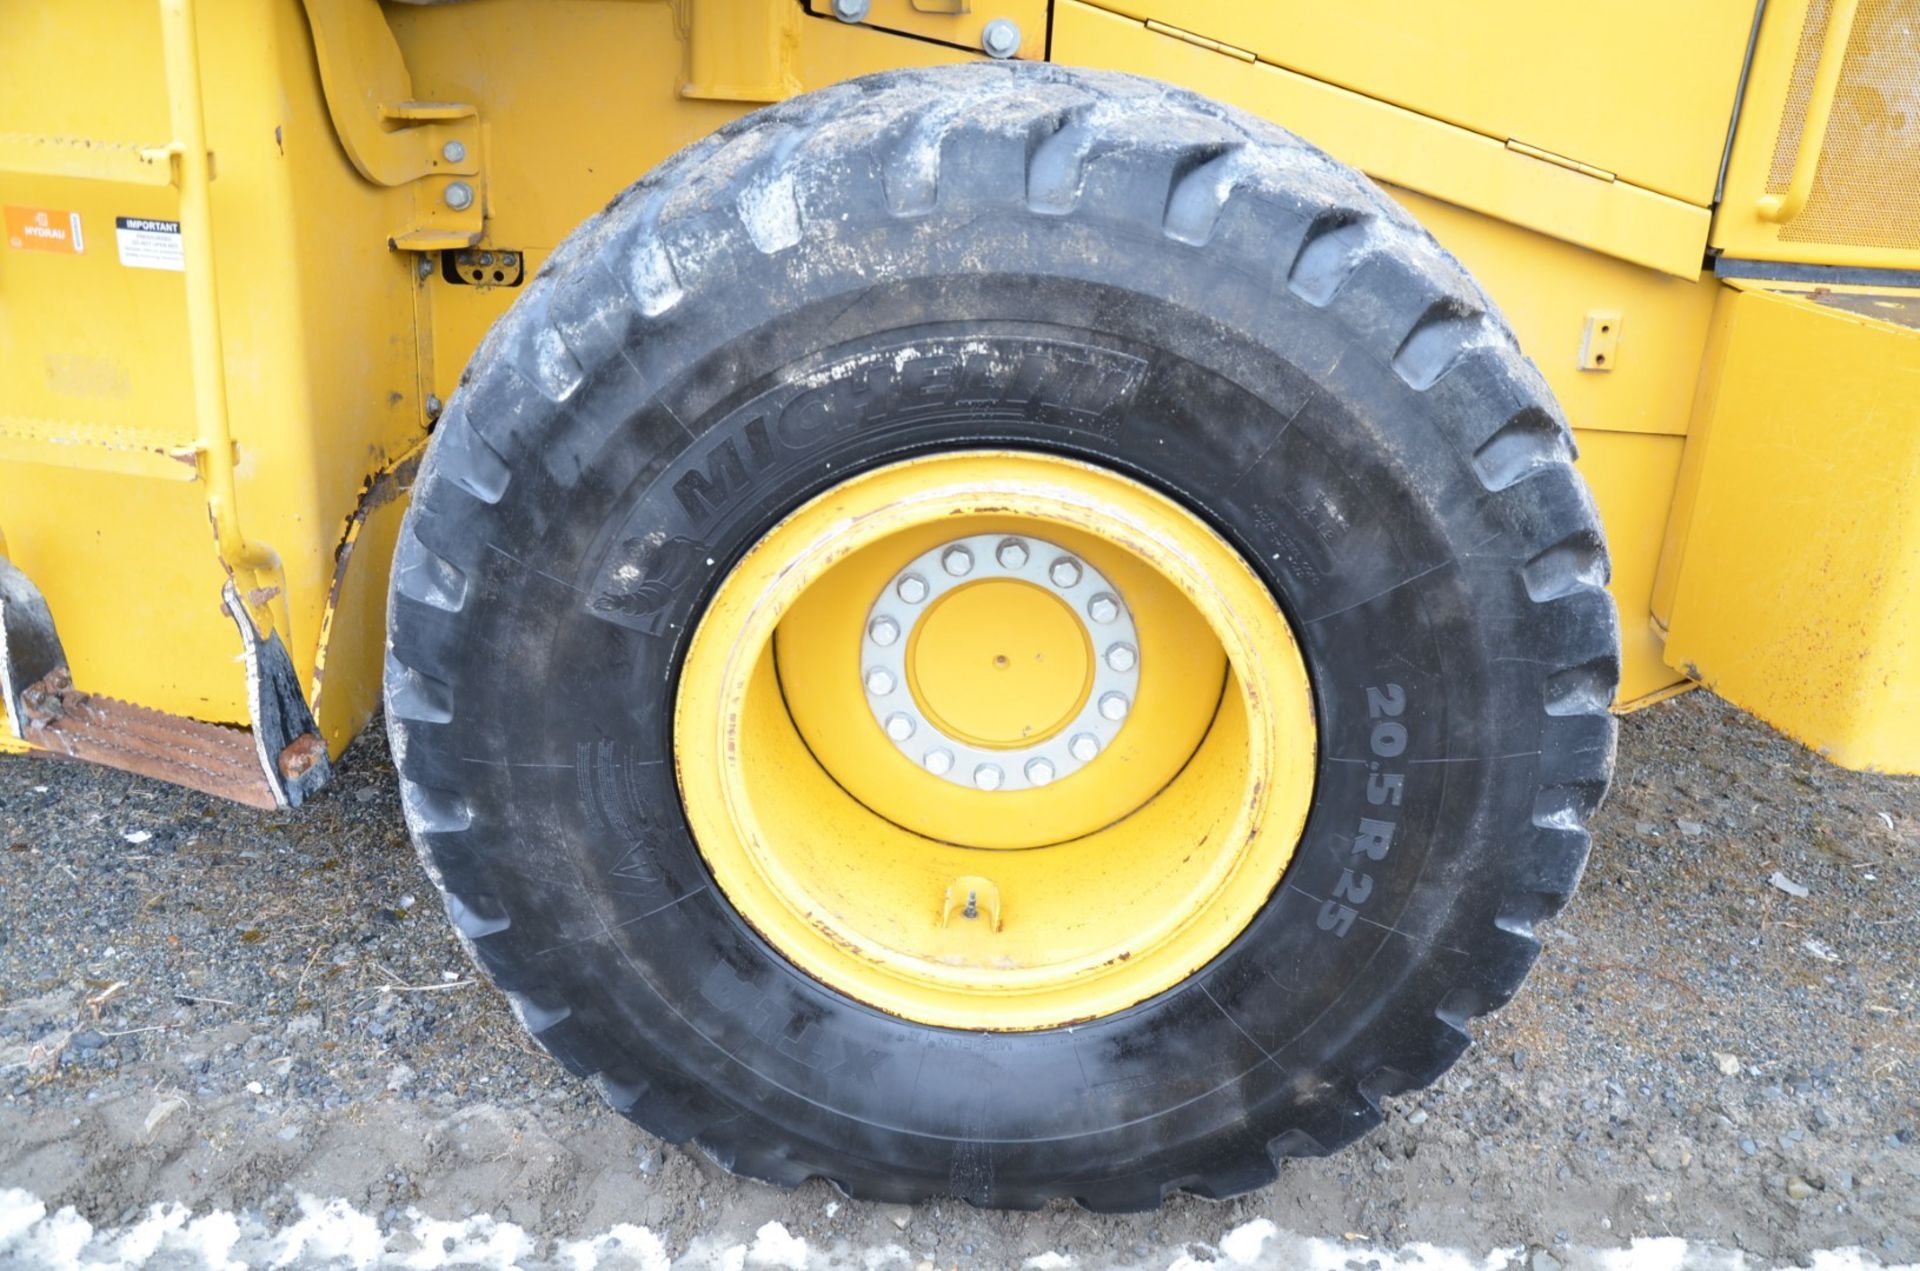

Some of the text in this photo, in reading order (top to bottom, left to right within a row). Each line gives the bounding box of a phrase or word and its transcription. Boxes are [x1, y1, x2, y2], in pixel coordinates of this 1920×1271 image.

[126, 219, 177, 232] IMPORTANT
[672, 350, 1131, 532] MICHELIN
[1316, 867, 1375, 938] 25
